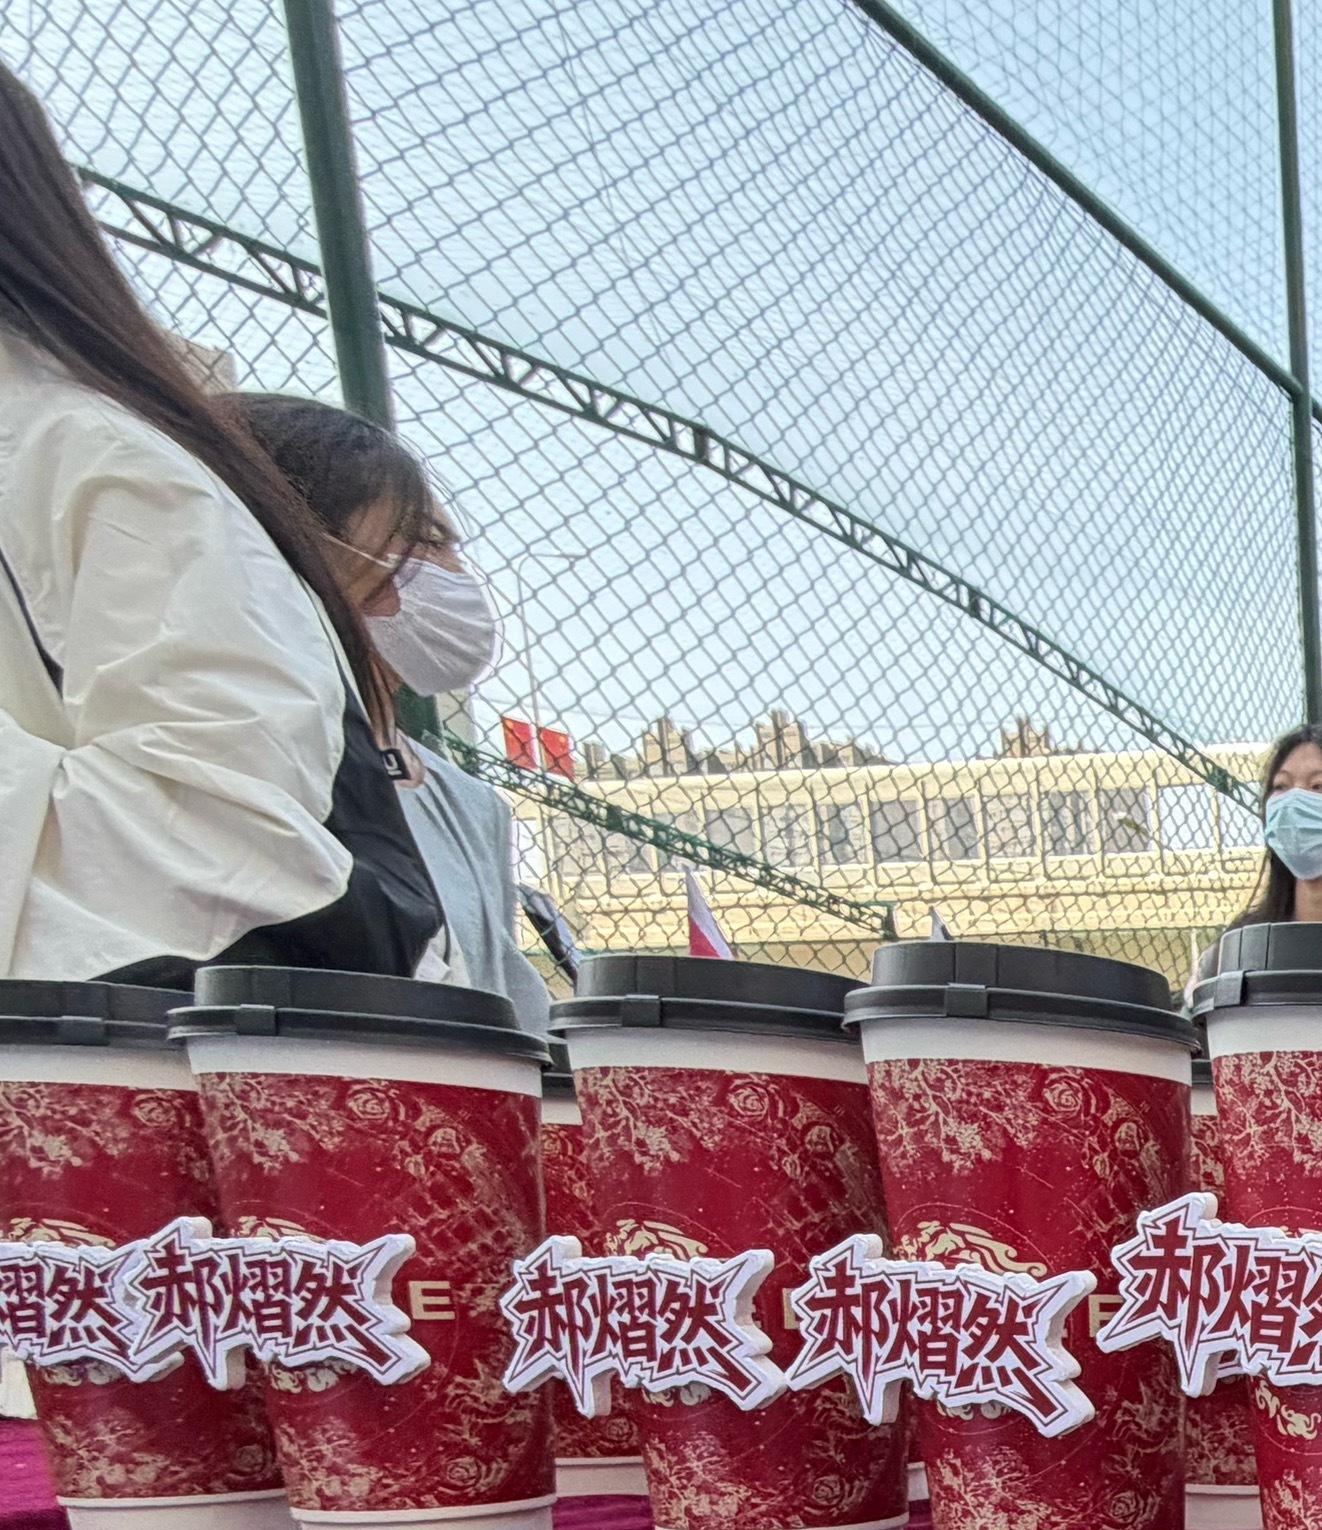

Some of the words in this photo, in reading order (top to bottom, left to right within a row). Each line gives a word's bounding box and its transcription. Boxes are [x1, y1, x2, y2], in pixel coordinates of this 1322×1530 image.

[138, 1246, 396, 1370] 郝熠然
[515, 1266, 761, 1393] 郝熠然
[805, 1258, 1063, 1415] 郝熠然
